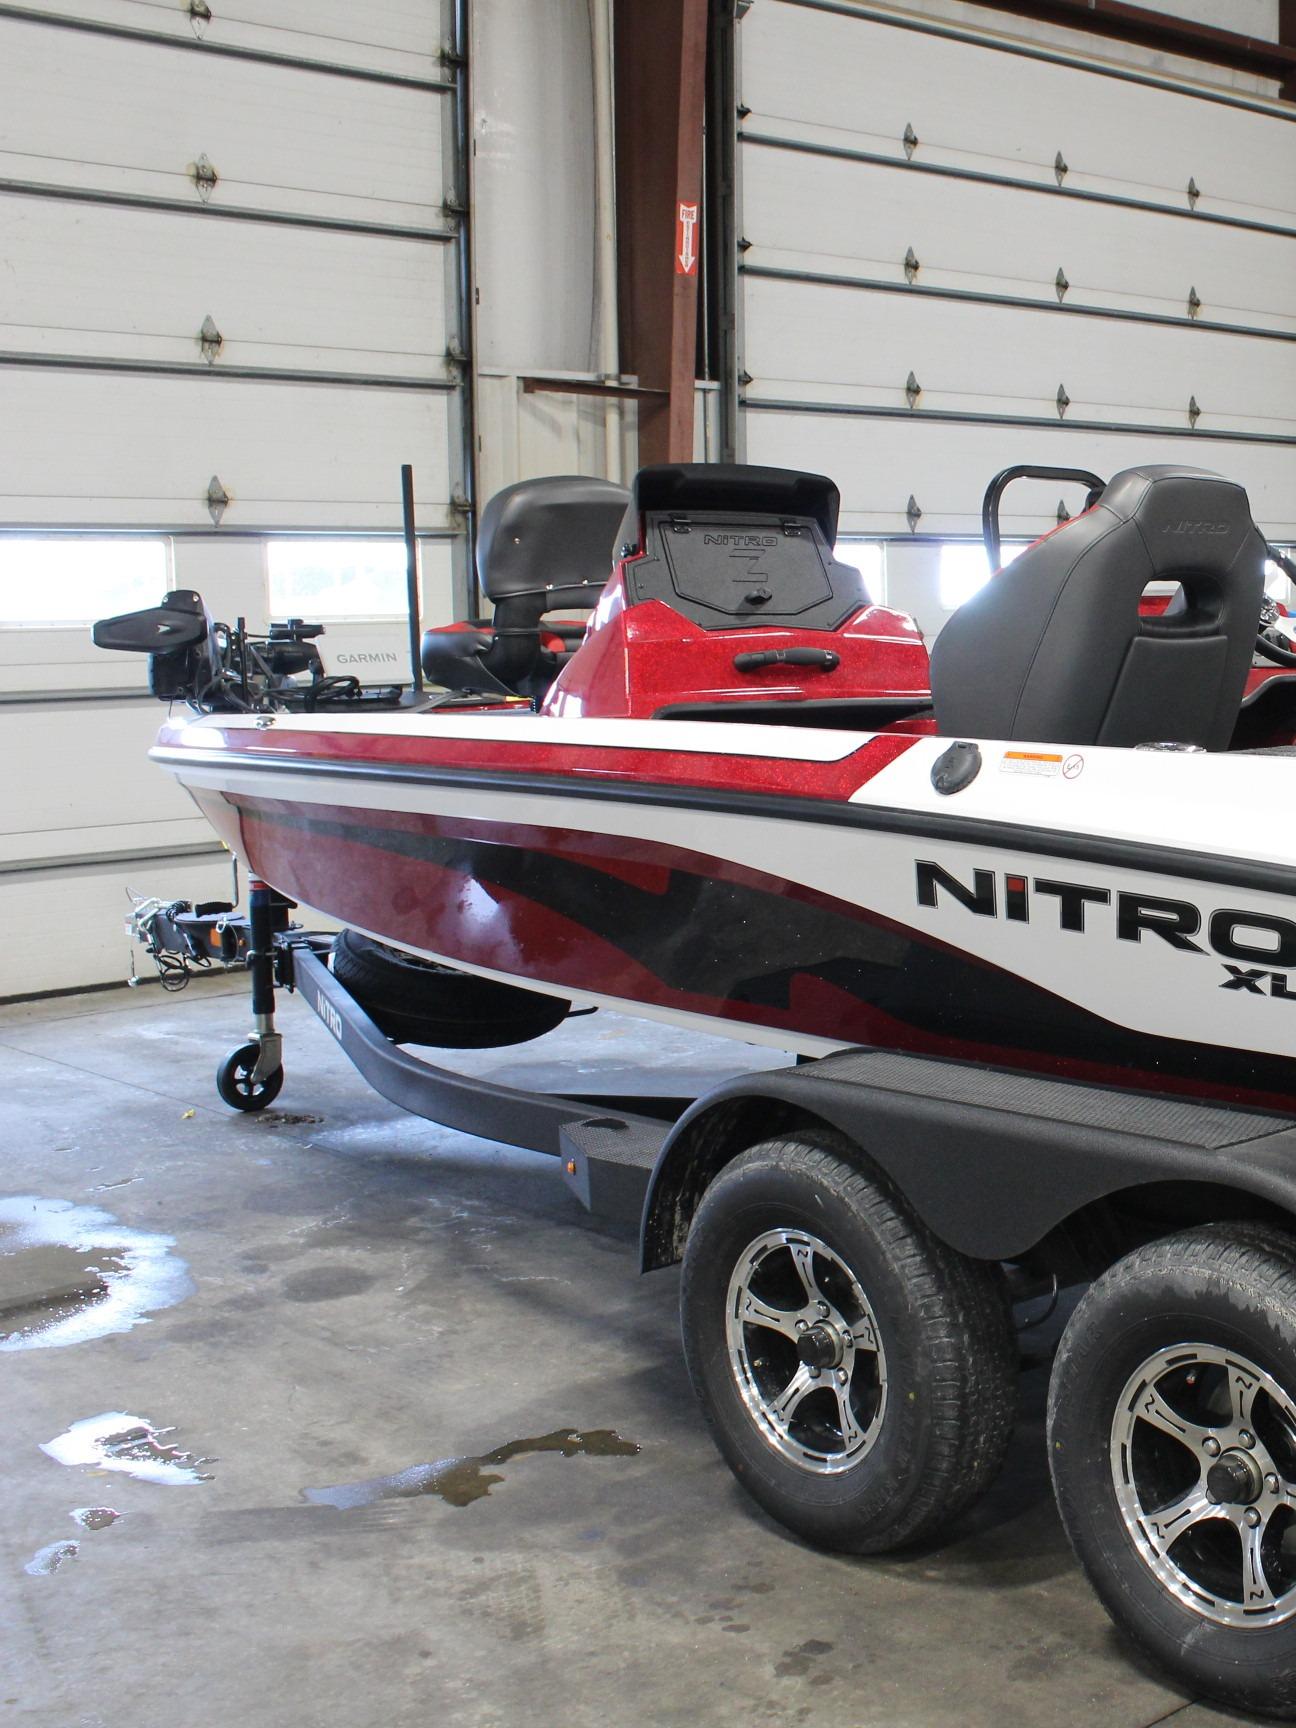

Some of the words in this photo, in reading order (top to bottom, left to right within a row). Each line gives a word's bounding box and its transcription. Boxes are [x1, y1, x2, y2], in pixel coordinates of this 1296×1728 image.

[703, 533, 778, 547] NITRO
[336, 651, 398, 665] GARMIN
[316, 989, 343, 1041] NITRO
